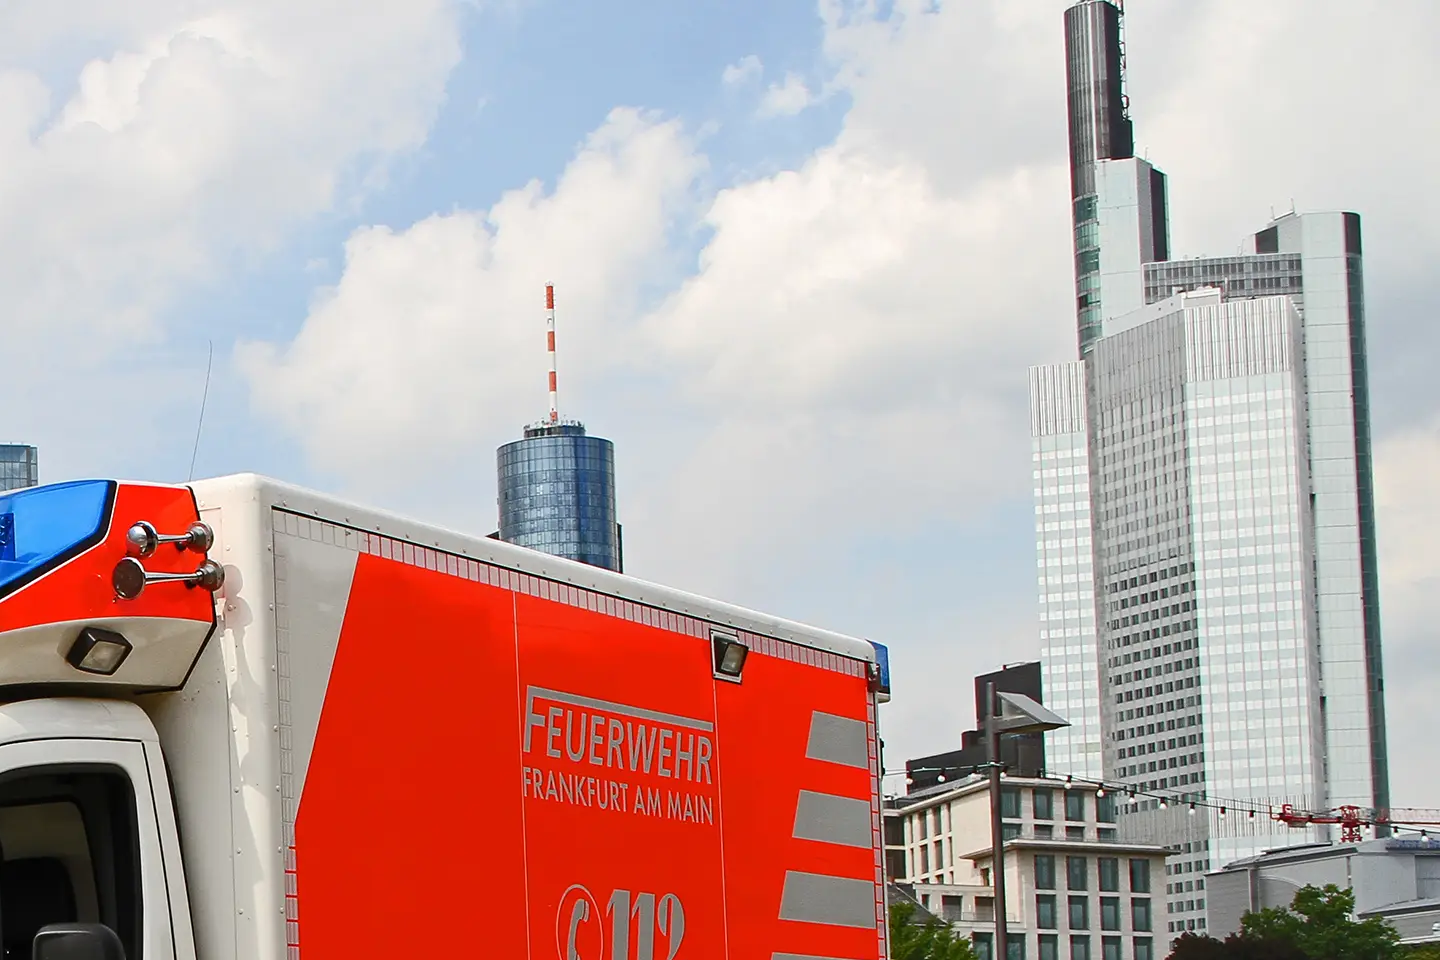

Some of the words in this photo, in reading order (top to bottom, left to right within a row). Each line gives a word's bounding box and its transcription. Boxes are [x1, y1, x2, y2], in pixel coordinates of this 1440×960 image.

[523, 684, 713, 785] FEUERWEHR
[523, 766, 629, 812] FRANKFURT
[633, 784, 662, 818] AM
[667, 790, 713, 826] MAIN
